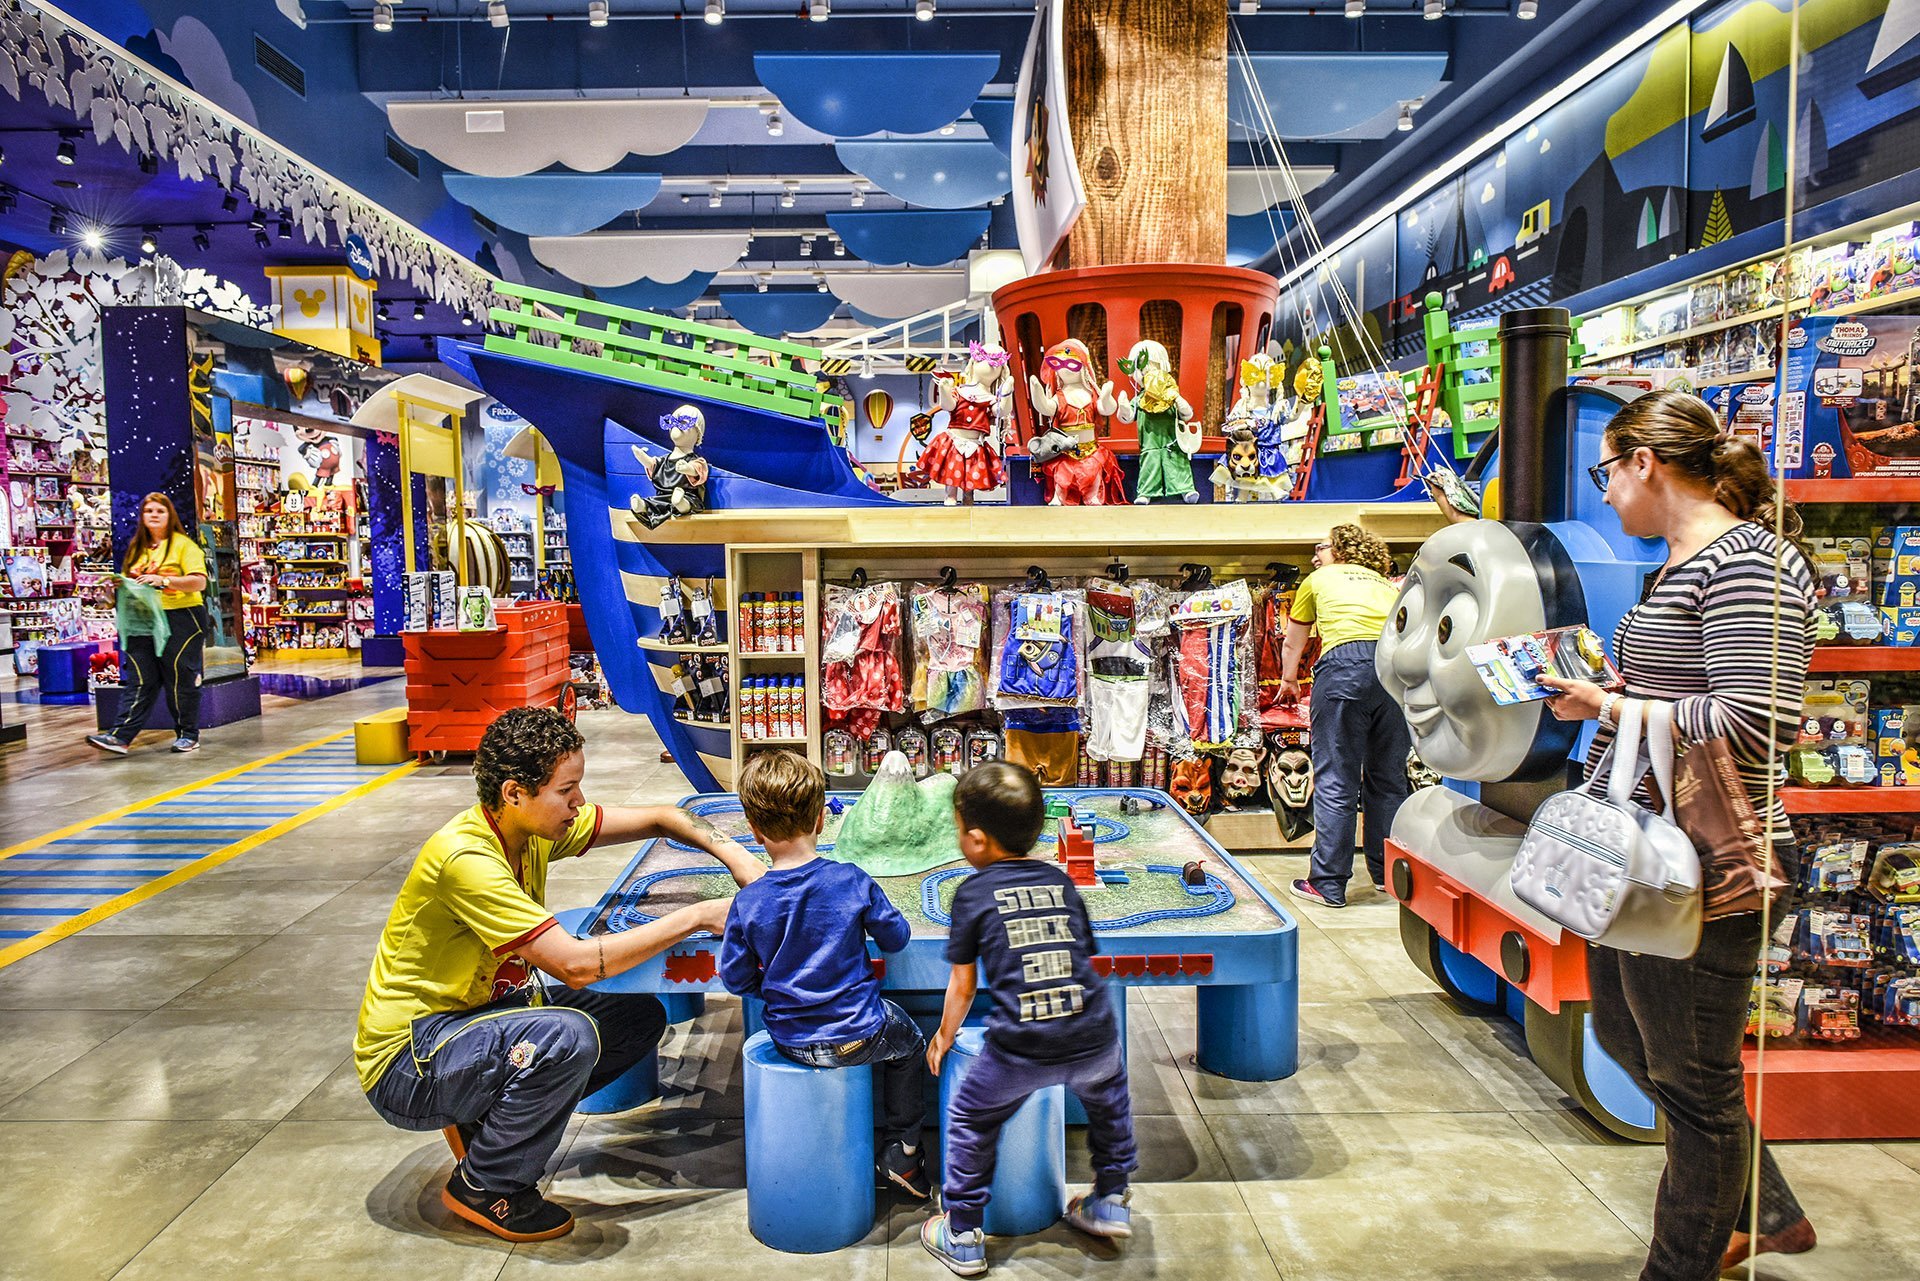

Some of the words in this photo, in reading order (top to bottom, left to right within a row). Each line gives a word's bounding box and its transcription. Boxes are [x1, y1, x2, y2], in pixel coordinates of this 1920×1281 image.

[347, 239, 373, 278] Disney
[1825, 338, 1875, 348] MOTORIZED
[1828, 347, 1869, 355] RAILWAY
[491, 407, 518, 417] FROZ
